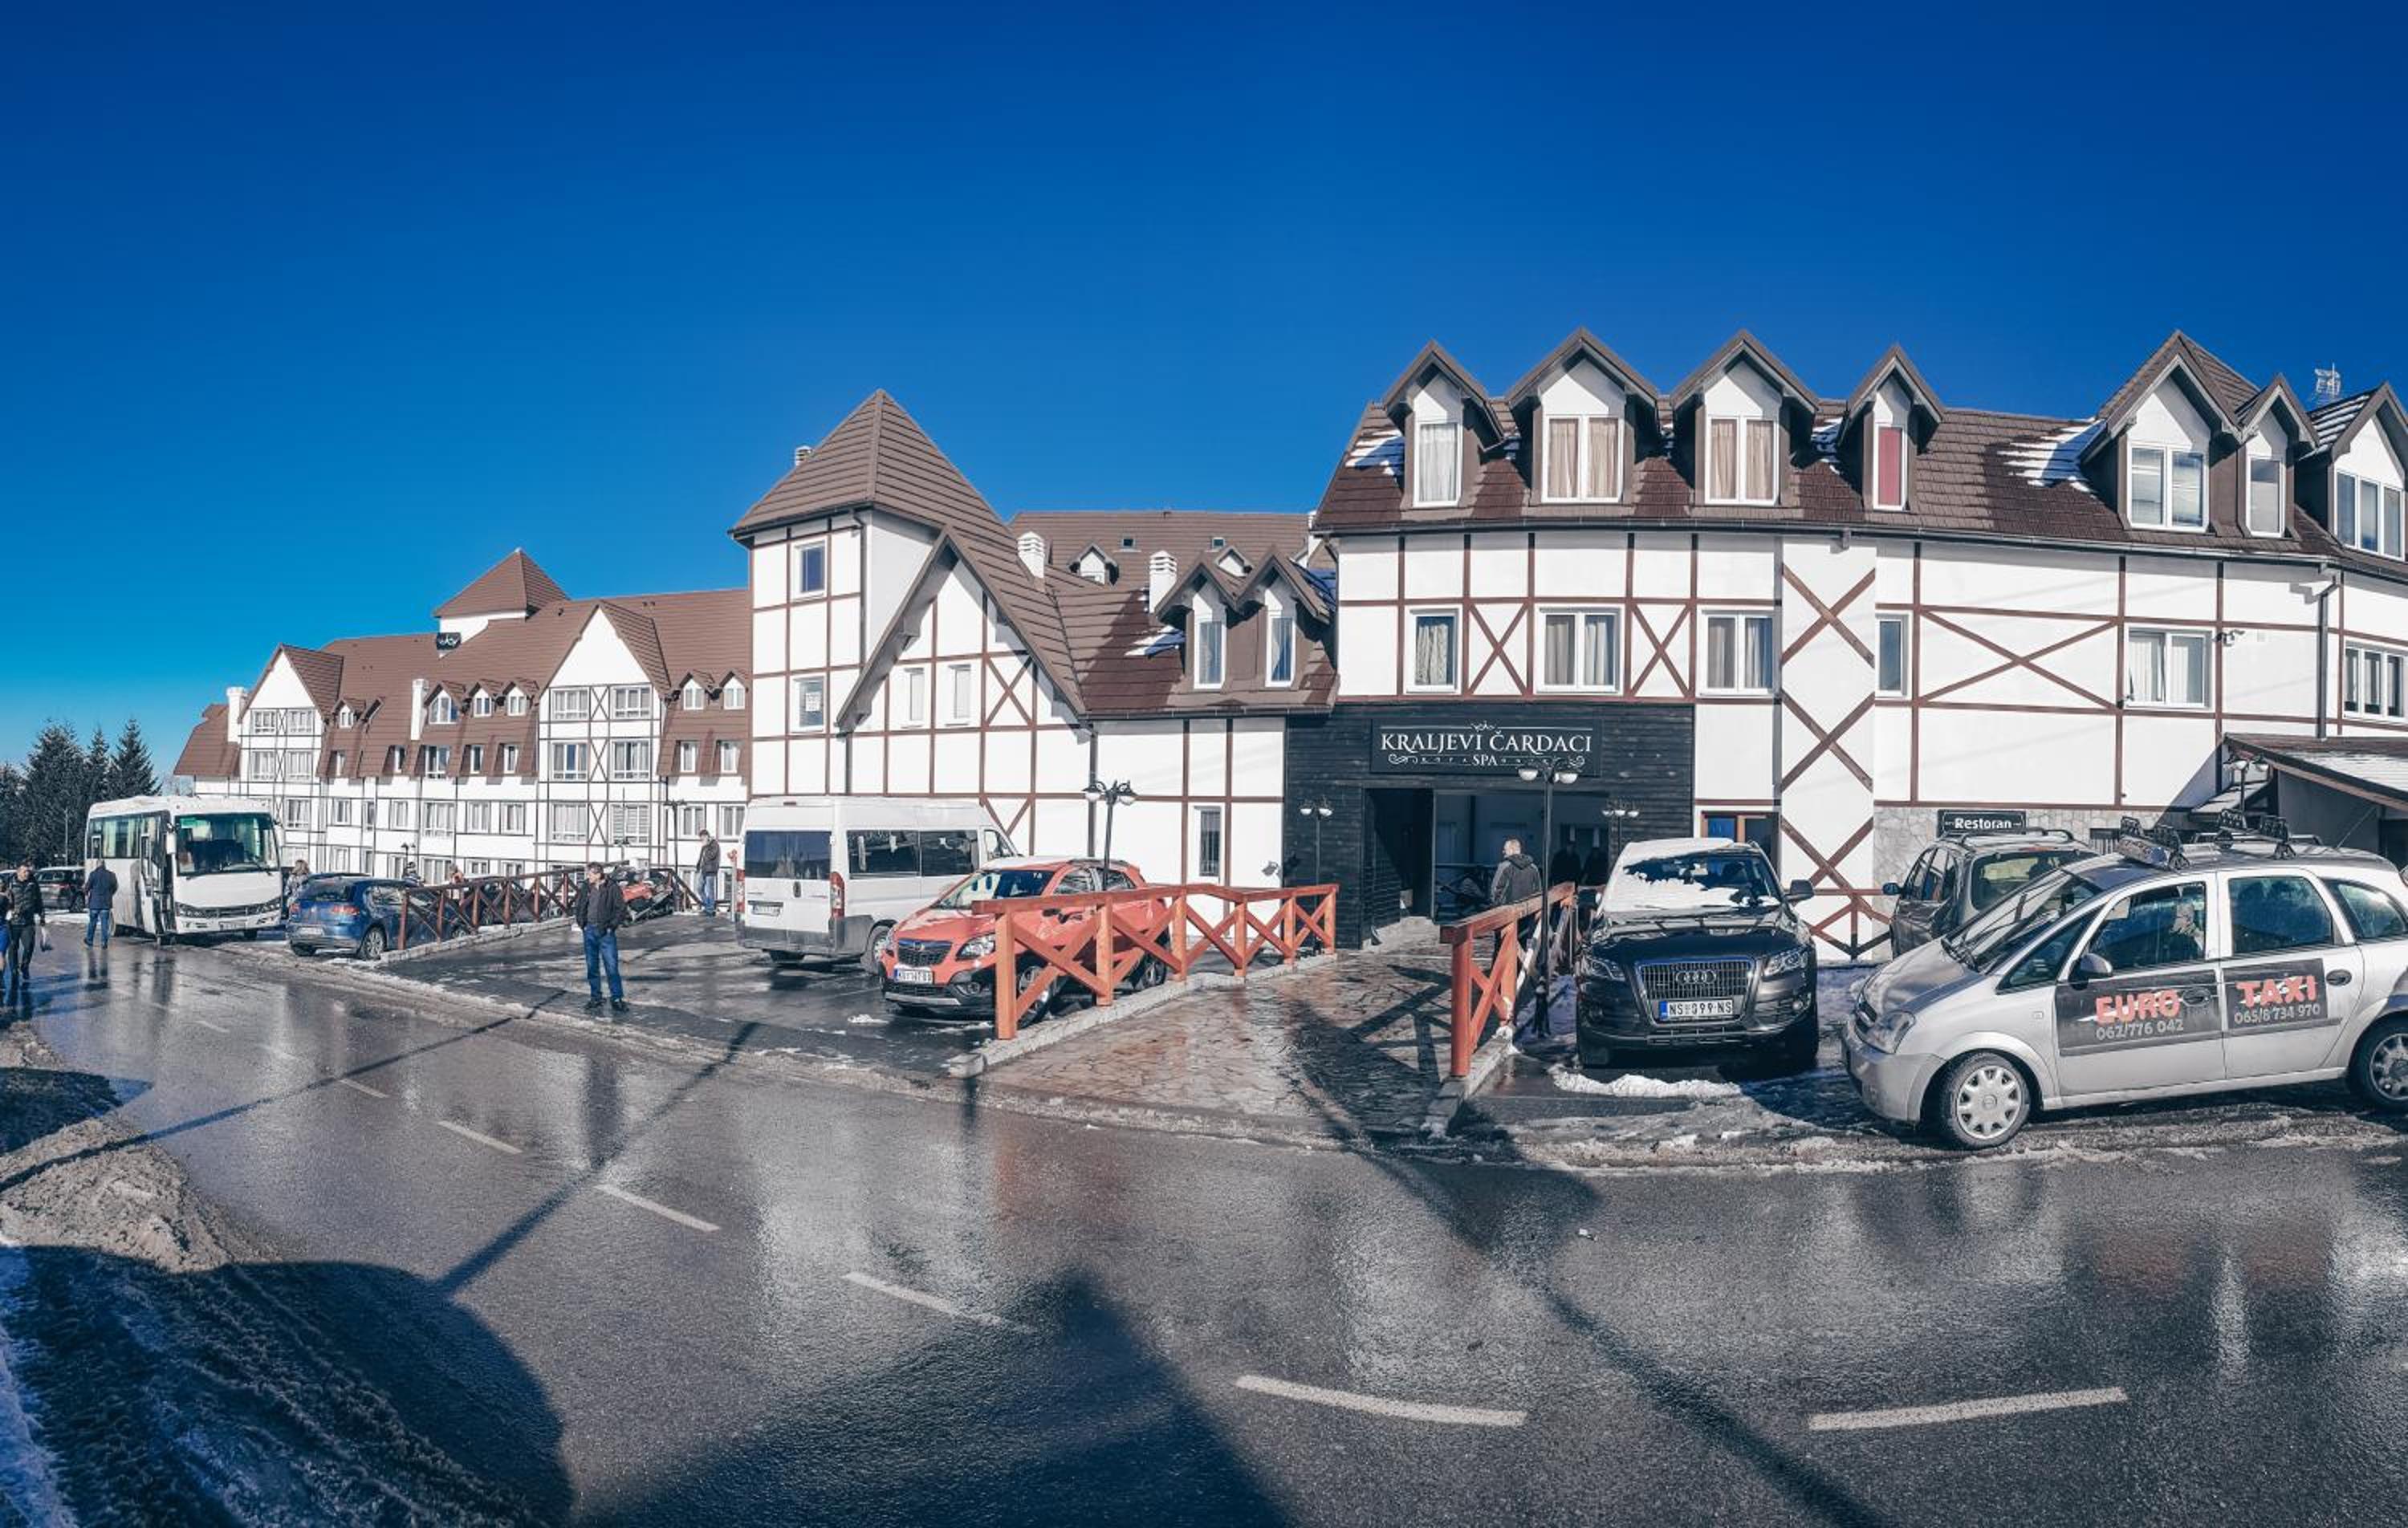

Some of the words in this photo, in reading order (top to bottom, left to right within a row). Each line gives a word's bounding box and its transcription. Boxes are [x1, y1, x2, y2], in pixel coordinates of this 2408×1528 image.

[1380, 732, 1483, 754] KRALJEVI
[1489, 729, 1592, 754] ČARDACI
[1473, 754, 1499, 766] SPA
[1954, 818, 2012, 829] Restoran
[2096, 989, 2181, 1025] EURO
[2235, 975, 2316, 1008] TAXI
[2298, 1002, 2321, 1018] 970
[2157, 1018, 2183, 1034] 042
